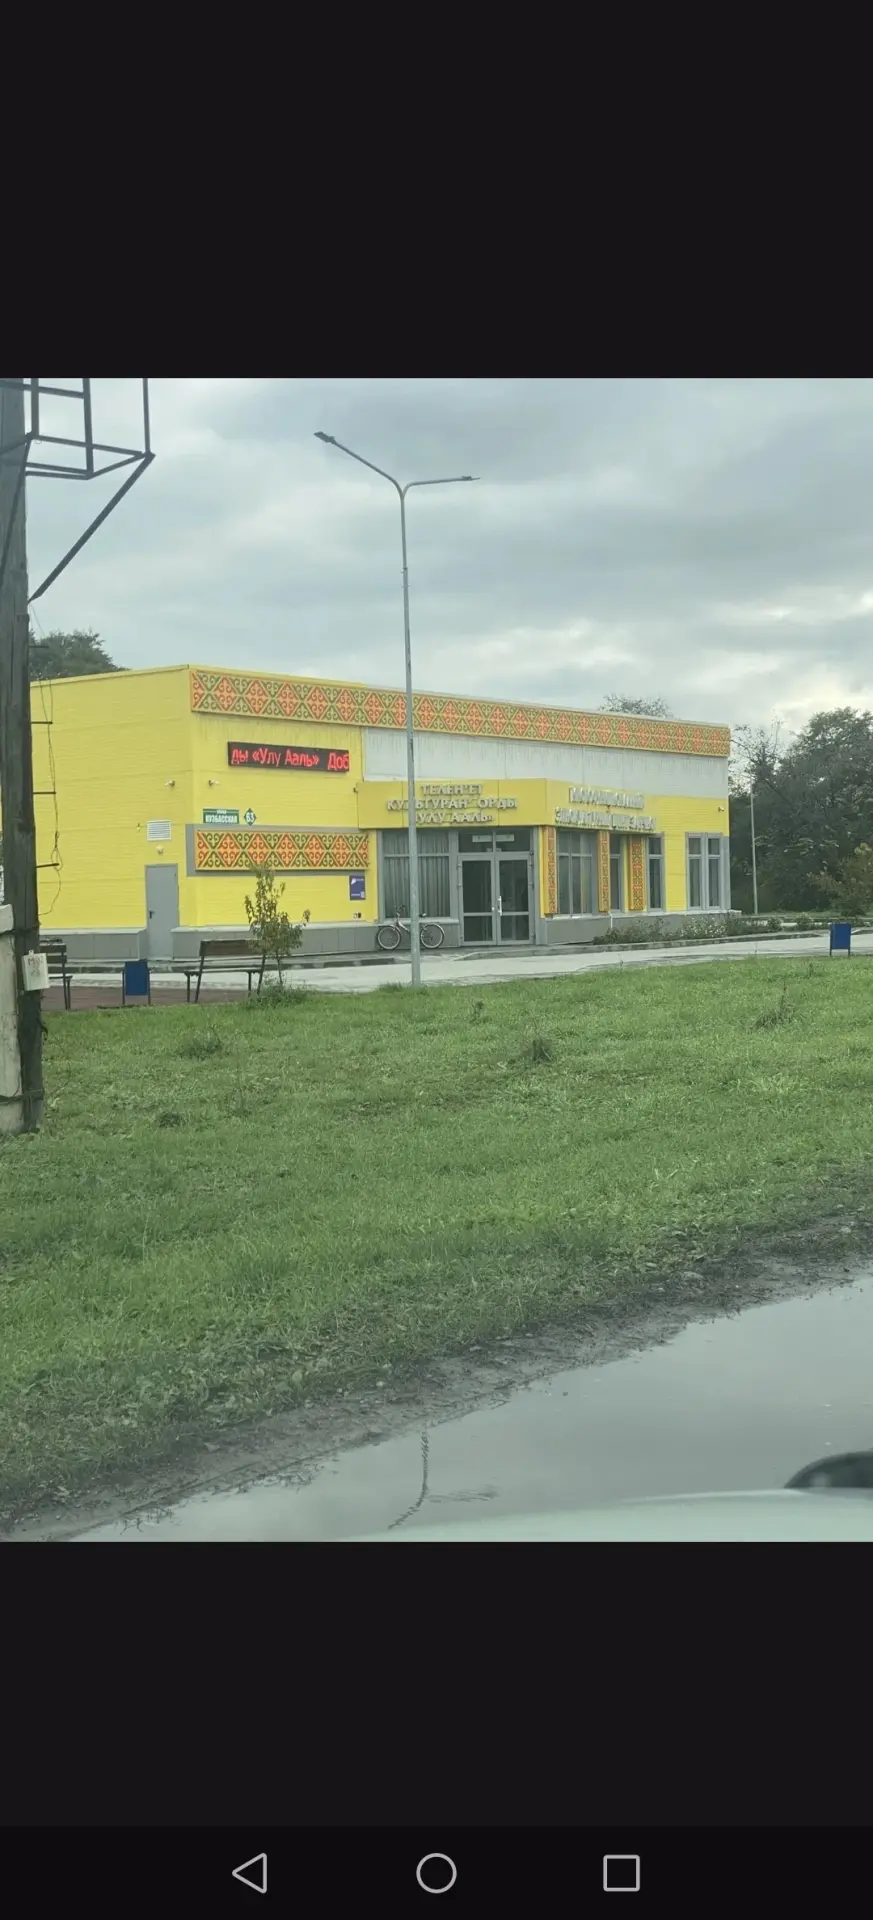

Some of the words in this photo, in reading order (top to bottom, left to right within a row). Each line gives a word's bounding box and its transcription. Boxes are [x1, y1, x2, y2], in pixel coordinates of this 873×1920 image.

[231, 749, 249, 765] ды
[252, 747, 281, 768] «Улу
[284, 749, 320, 767] Ааль»
[327, 752, 350, 771] Доб
